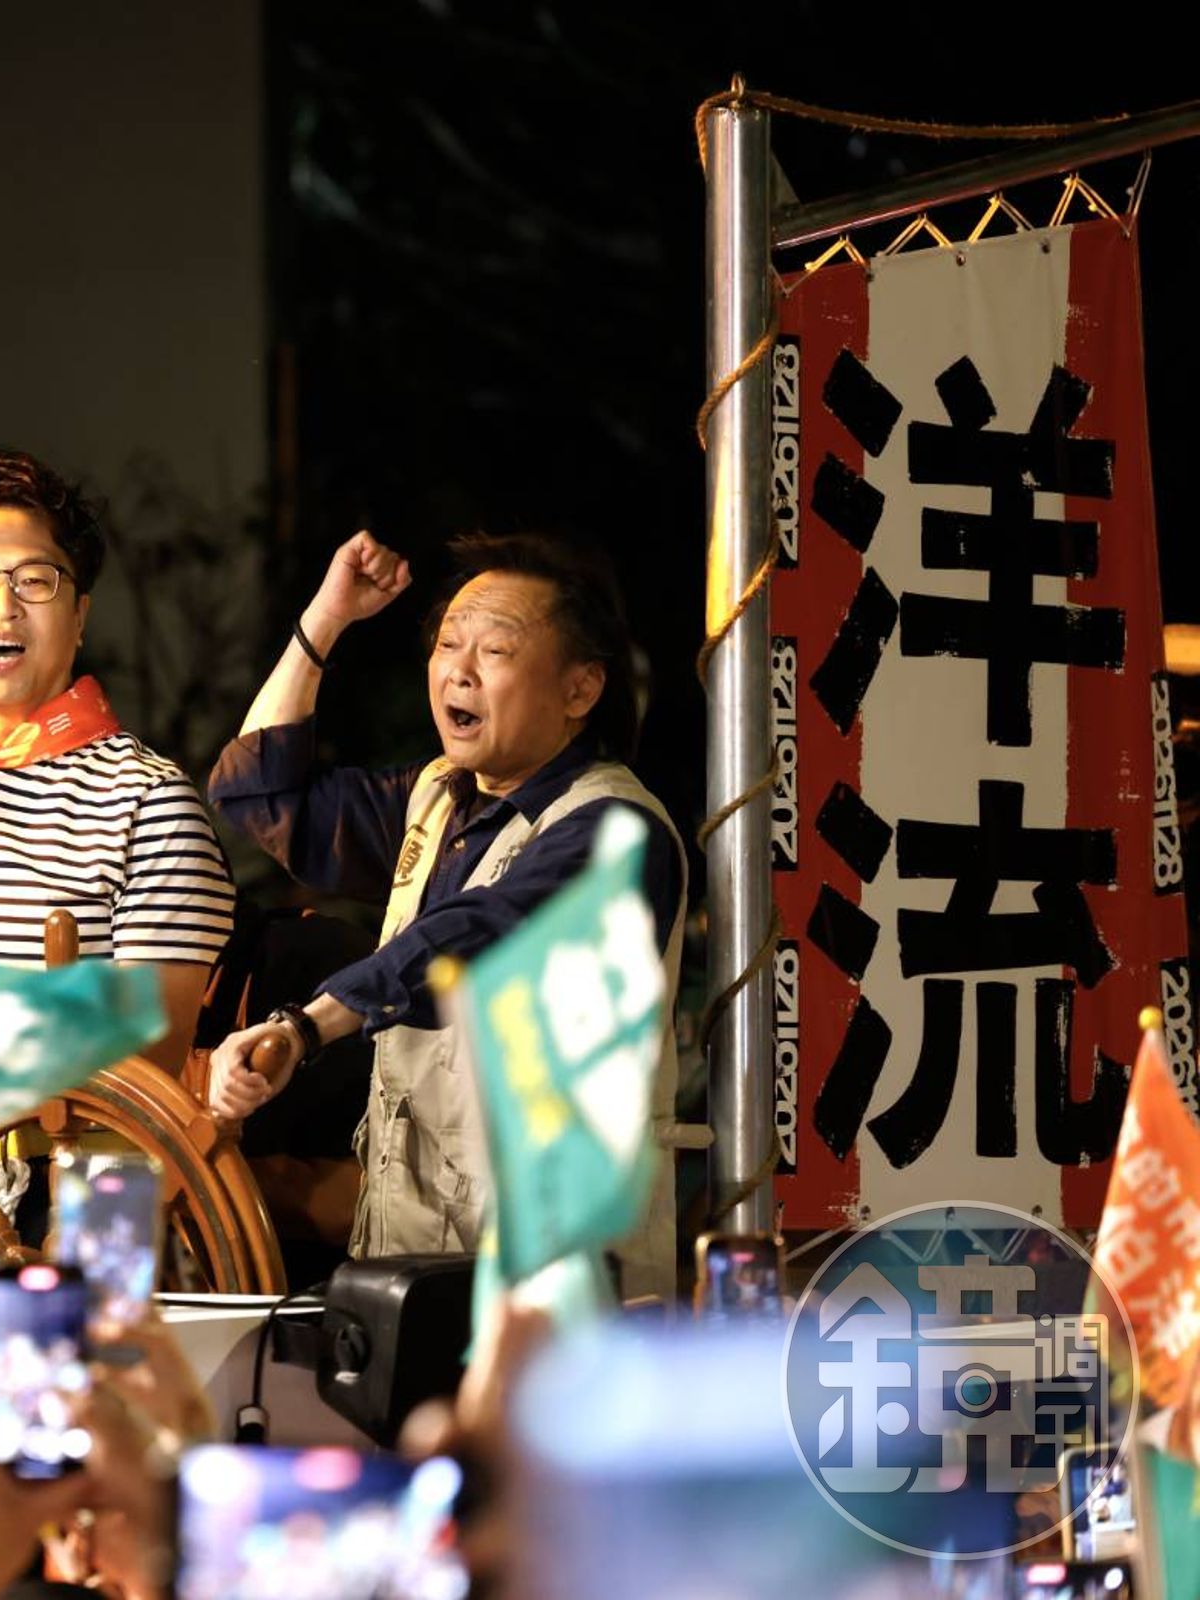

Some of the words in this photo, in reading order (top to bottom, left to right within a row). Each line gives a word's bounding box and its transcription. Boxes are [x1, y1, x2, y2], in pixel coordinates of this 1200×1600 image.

[772, 343, 799, 561] 20261128
[771, 644, 798, 863] 20261128
[807, 347, 1131, 1170] 洋流
[1151, 679, 1184, 888] 20261128
